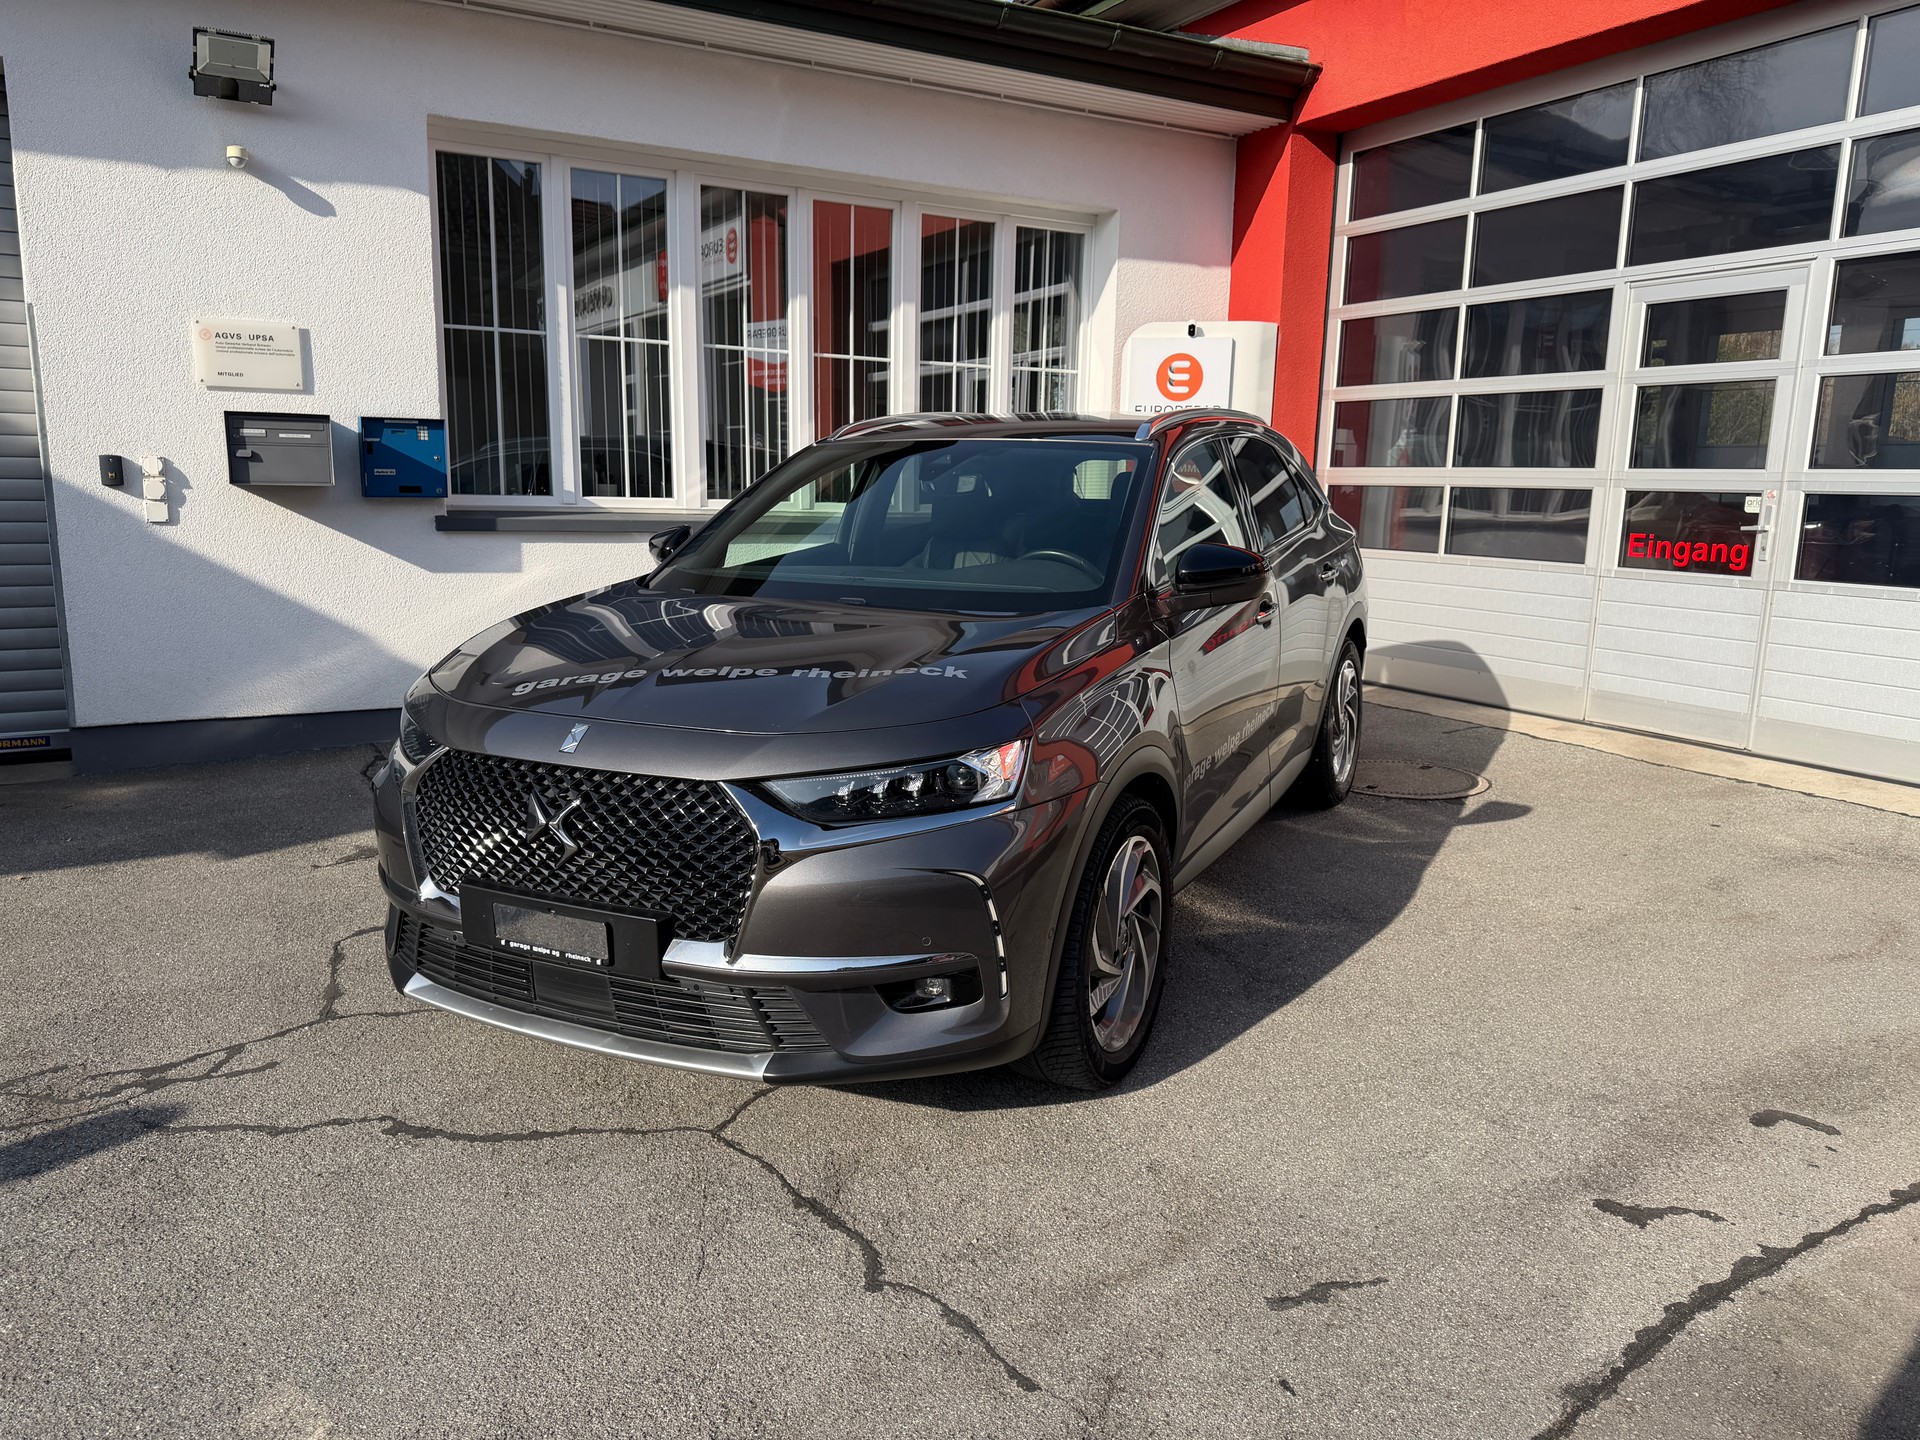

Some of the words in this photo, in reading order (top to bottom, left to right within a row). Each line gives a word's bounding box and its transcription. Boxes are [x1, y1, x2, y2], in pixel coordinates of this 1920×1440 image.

[214, 332, 242, 340] AGVS
[248, 334, 274, 342] UPSA
[1627, 532, 1748, 570] Eingang
[512, 669, 647, 696] garage
[661, 666, 778, 678] welpe
[790, 666, 968, 680] rheineck
[1214, 731, 1240, 761] welpe
[1242, 702, 1276, 739] rheineck
[509, 941, 531, 950] garage
[532, 946, 550, 954] welpe
[565, 952, 591, 962] rheineck
